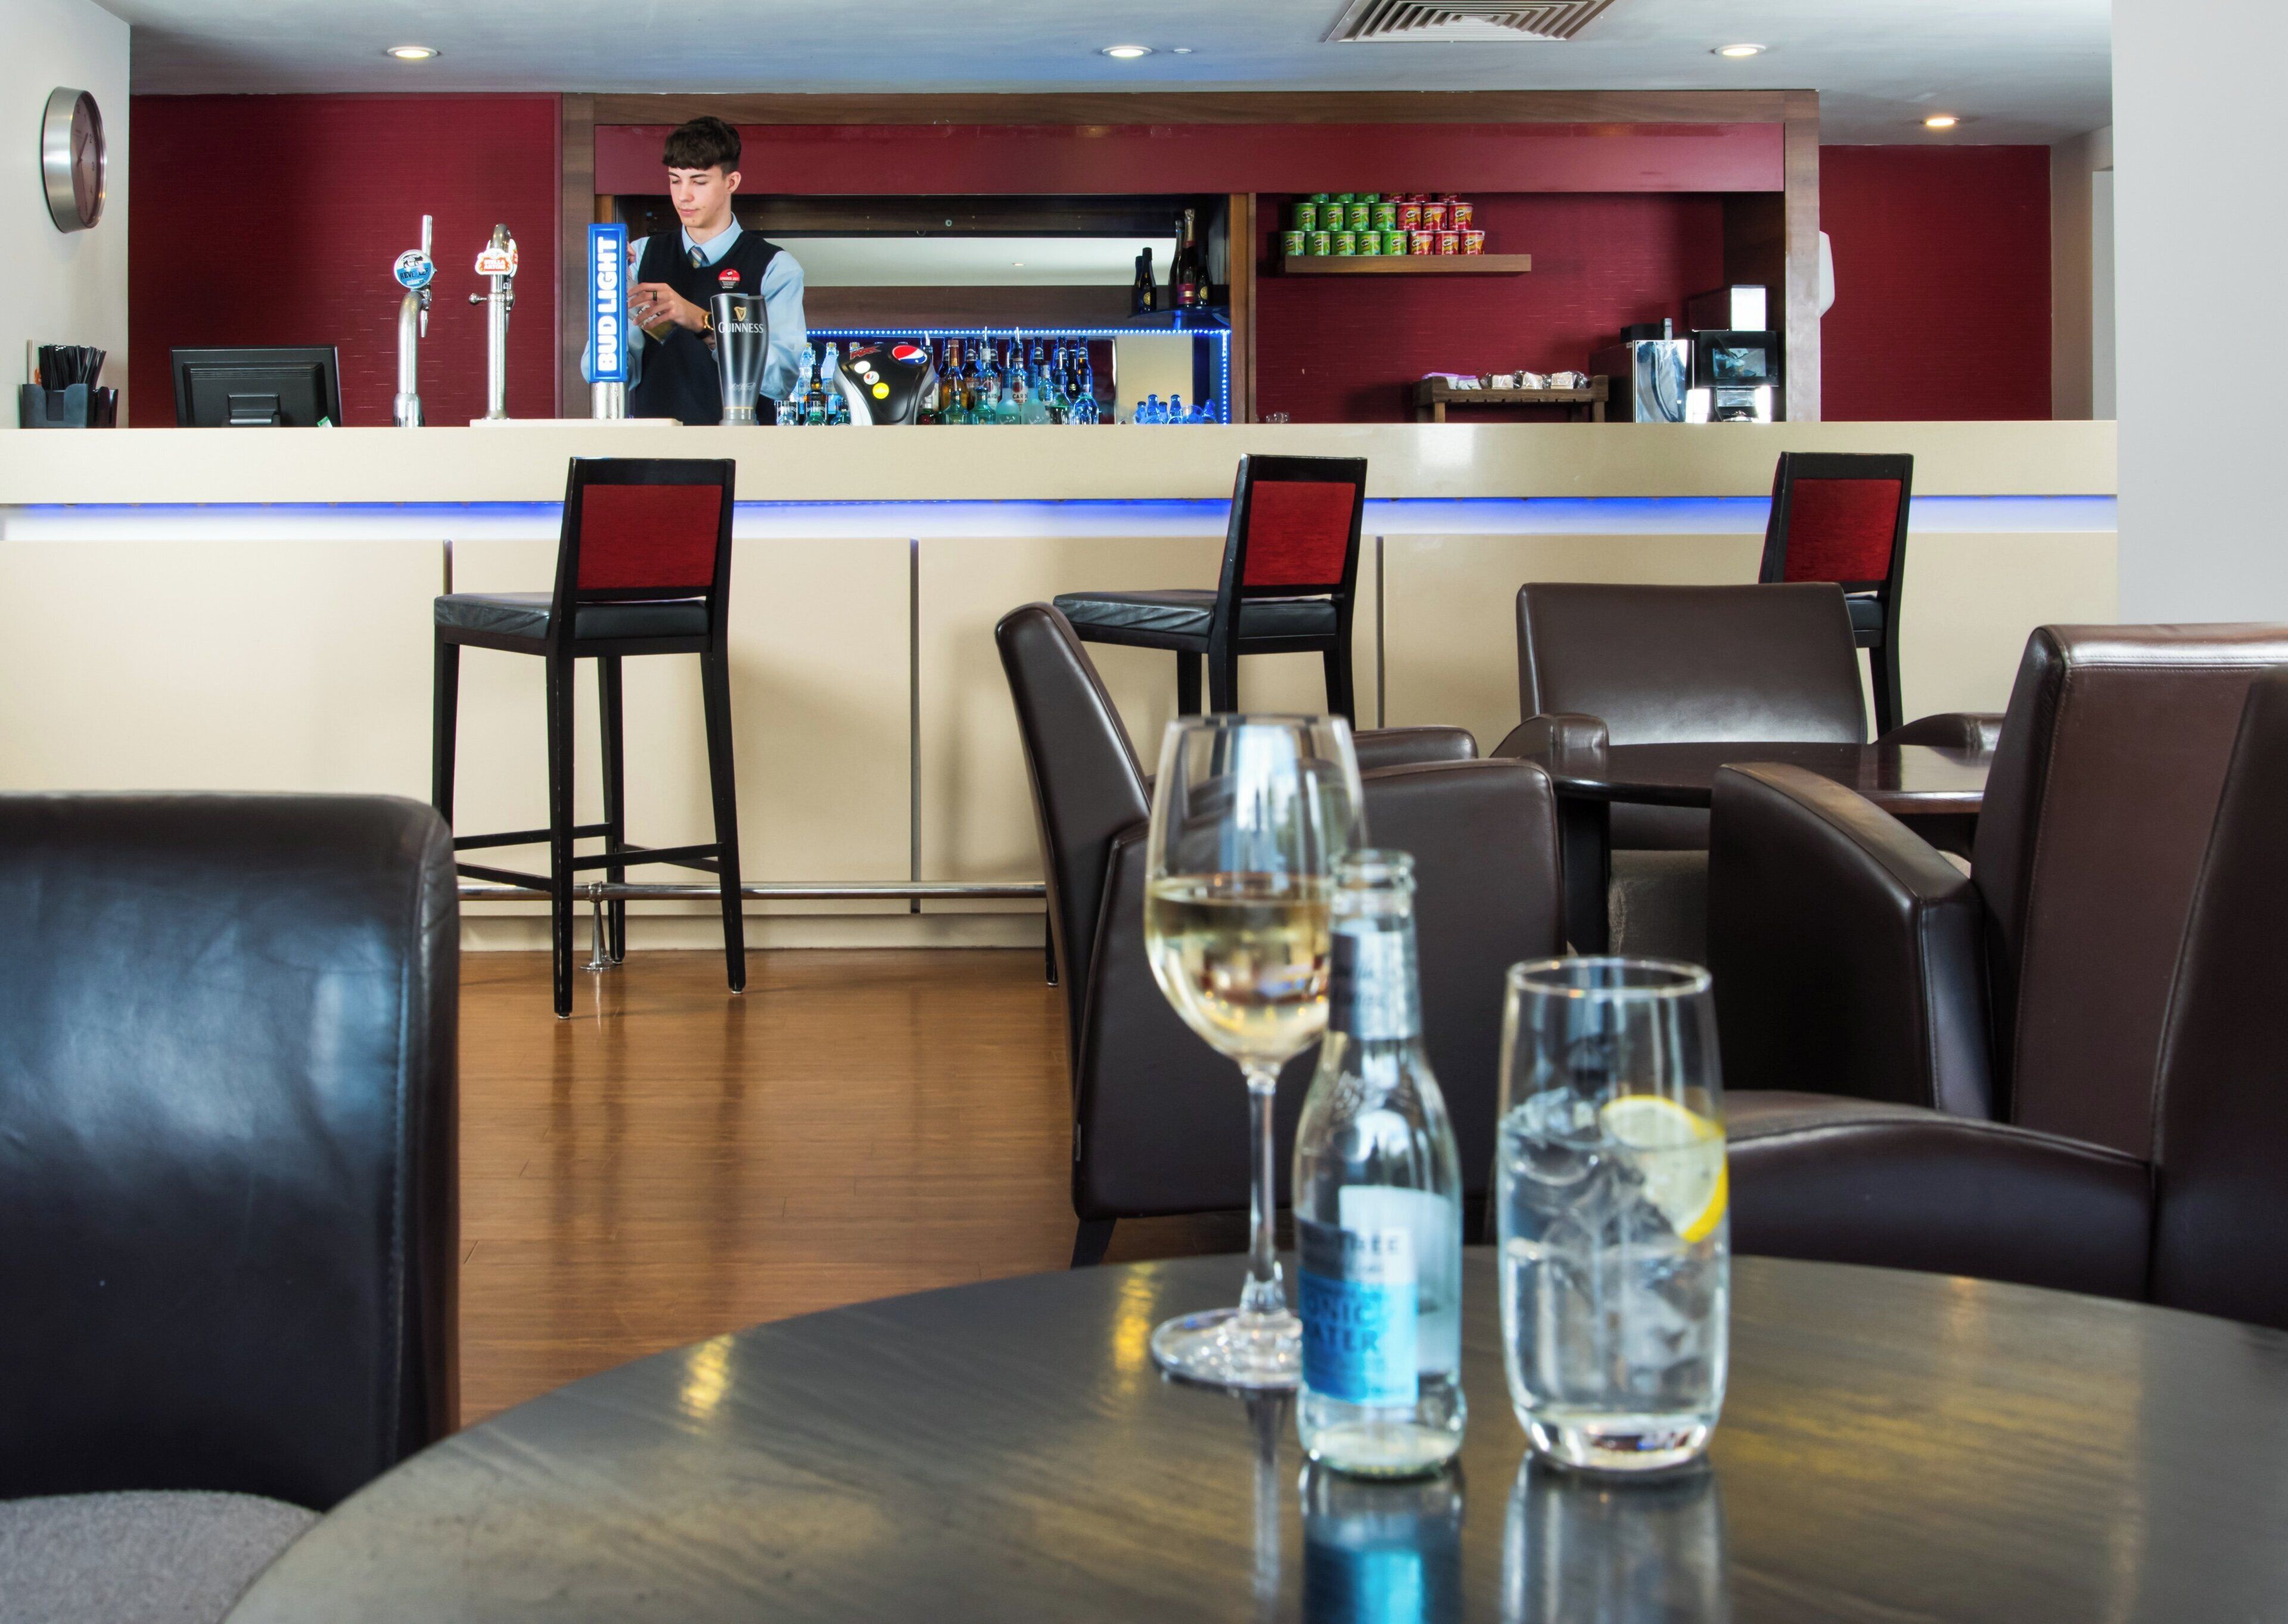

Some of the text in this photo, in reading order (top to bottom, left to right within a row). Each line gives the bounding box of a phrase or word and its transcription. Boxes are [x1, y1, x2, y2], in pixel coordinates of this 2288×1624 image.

[597, 237, 617, 371] BUD LIGHT
[718, 322, 764, 334] GUINNESS
